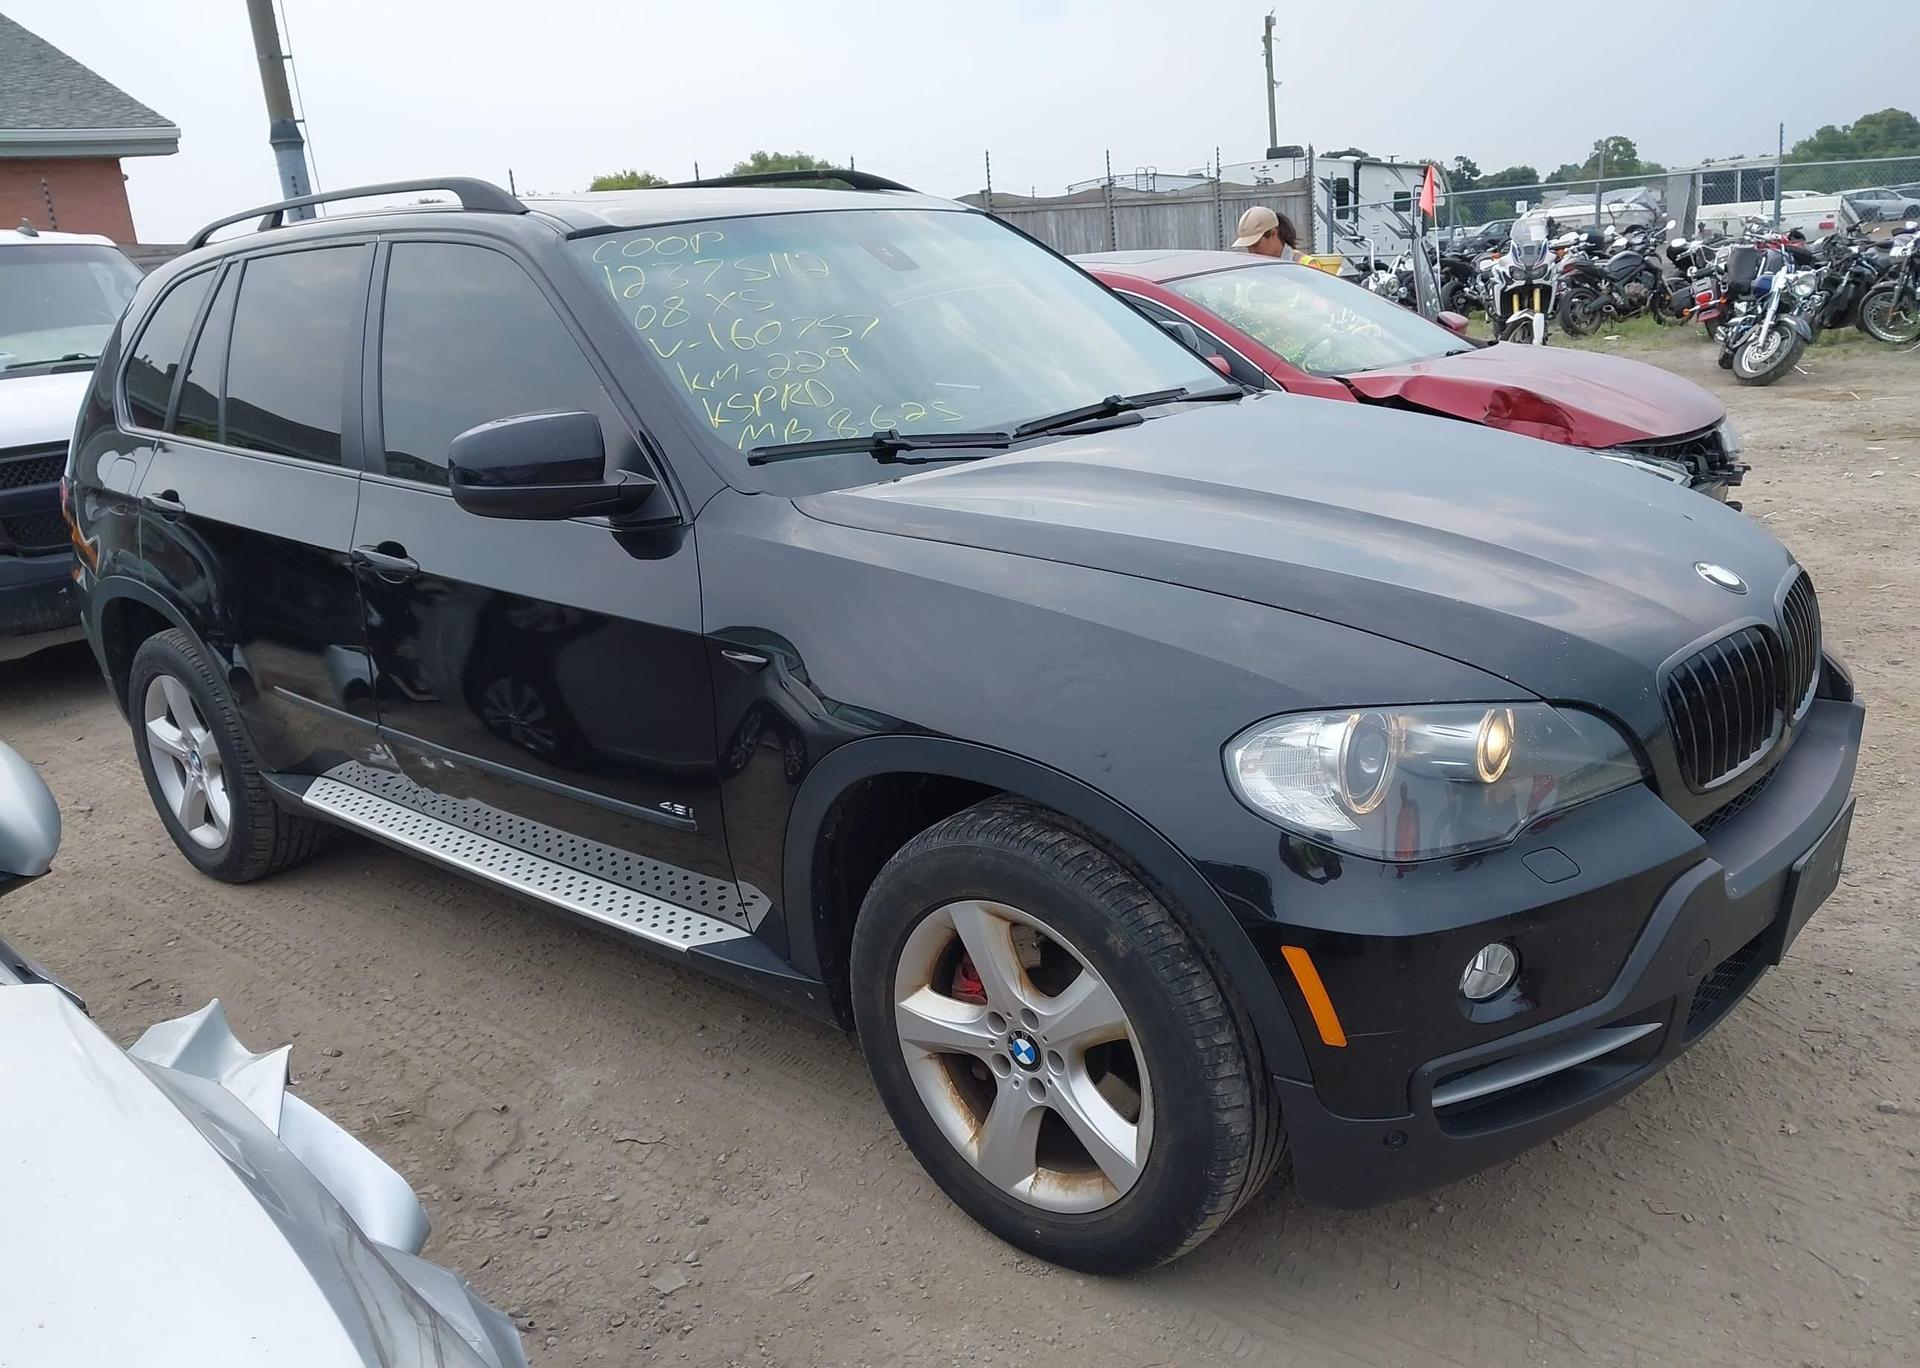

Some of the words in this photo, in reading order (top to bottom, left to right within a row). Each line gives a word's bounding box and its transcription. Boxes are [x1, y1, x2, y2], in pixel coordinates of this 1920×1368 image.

[593, 231, 724, 263] COOP
[634, 296, 691, 330] 08
[703, 378, 835, 429] KSPRD
[738, 418, 812, 450] MB
